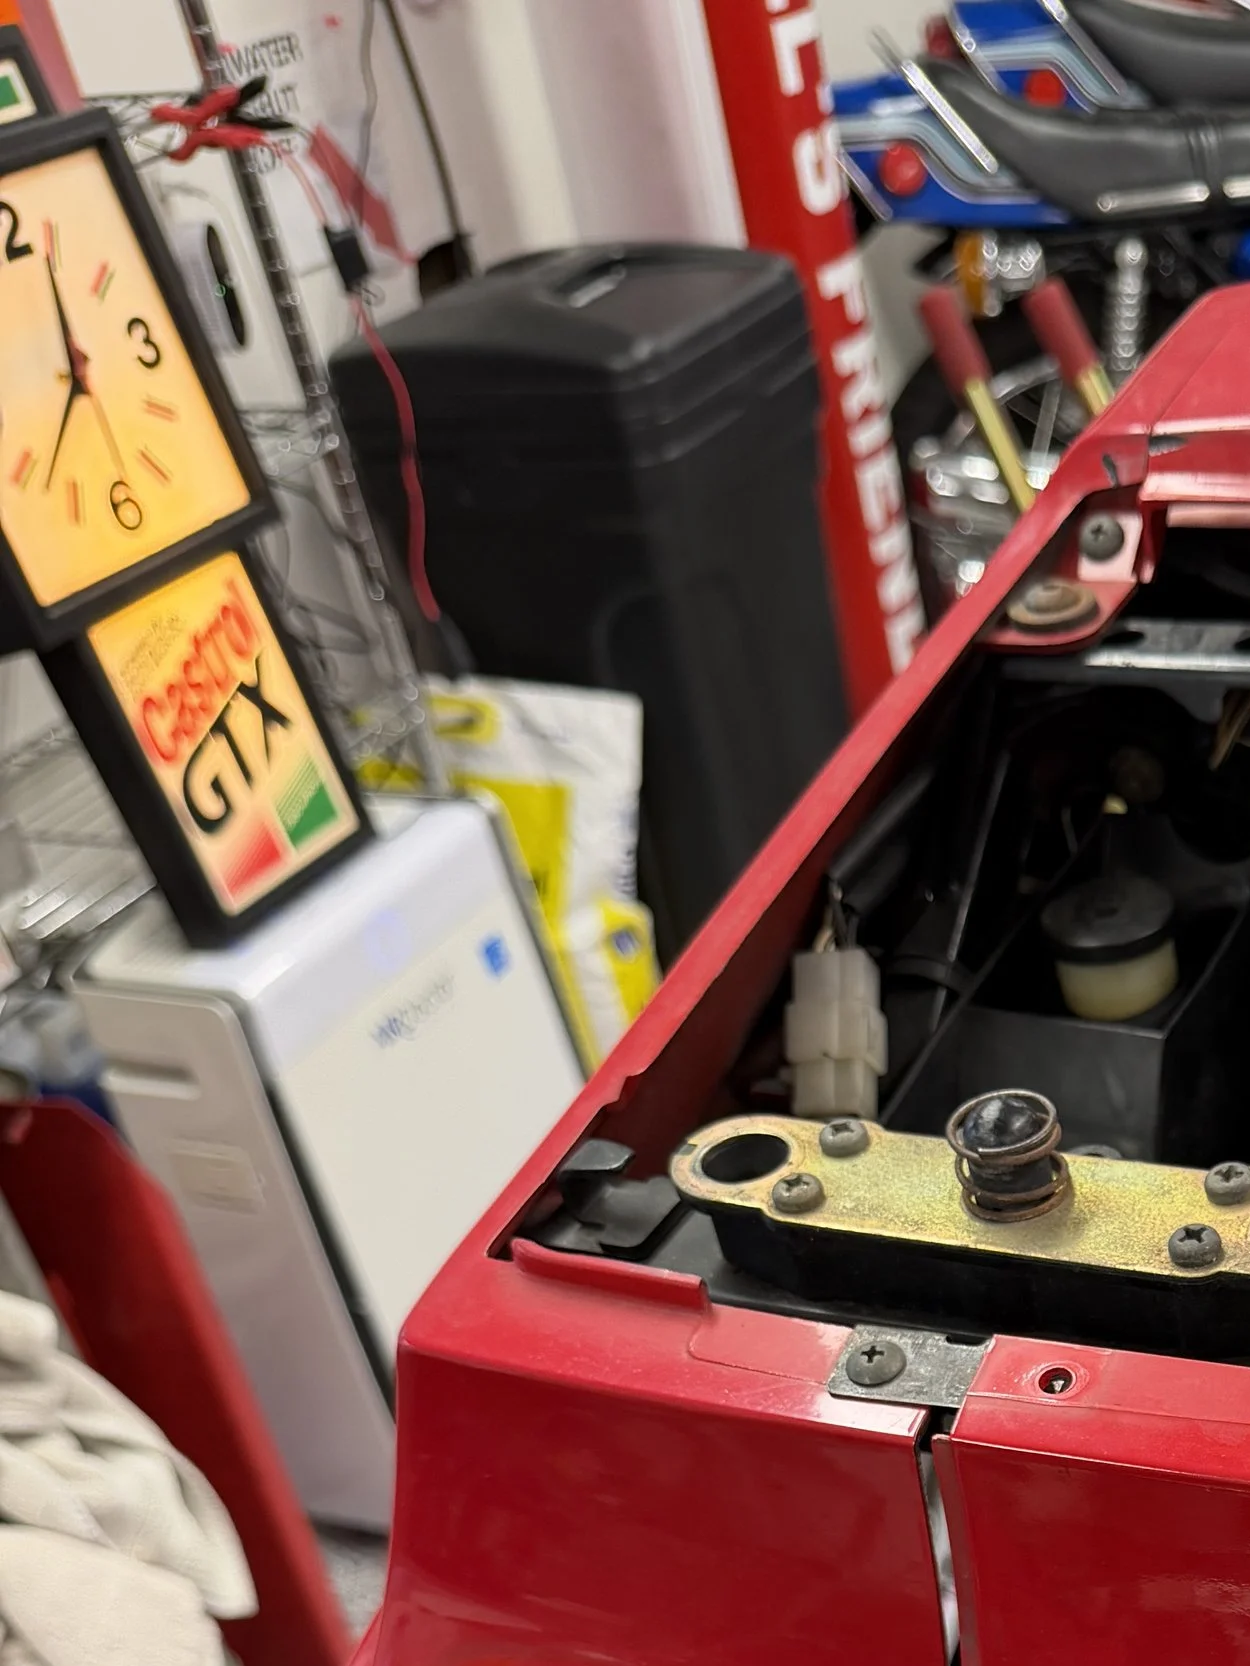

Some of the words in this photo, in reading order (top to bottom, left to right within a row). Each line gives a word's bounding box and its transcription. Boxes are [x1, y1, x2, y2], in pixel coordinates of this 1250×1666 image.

[766, 0, 849, 214] L'S
[127, 317, 161, 369] 3
[110, 480, 143, 530] 6
[142, 577, 258, 764] Castrol
[183, 652, 291, 834] GTX
